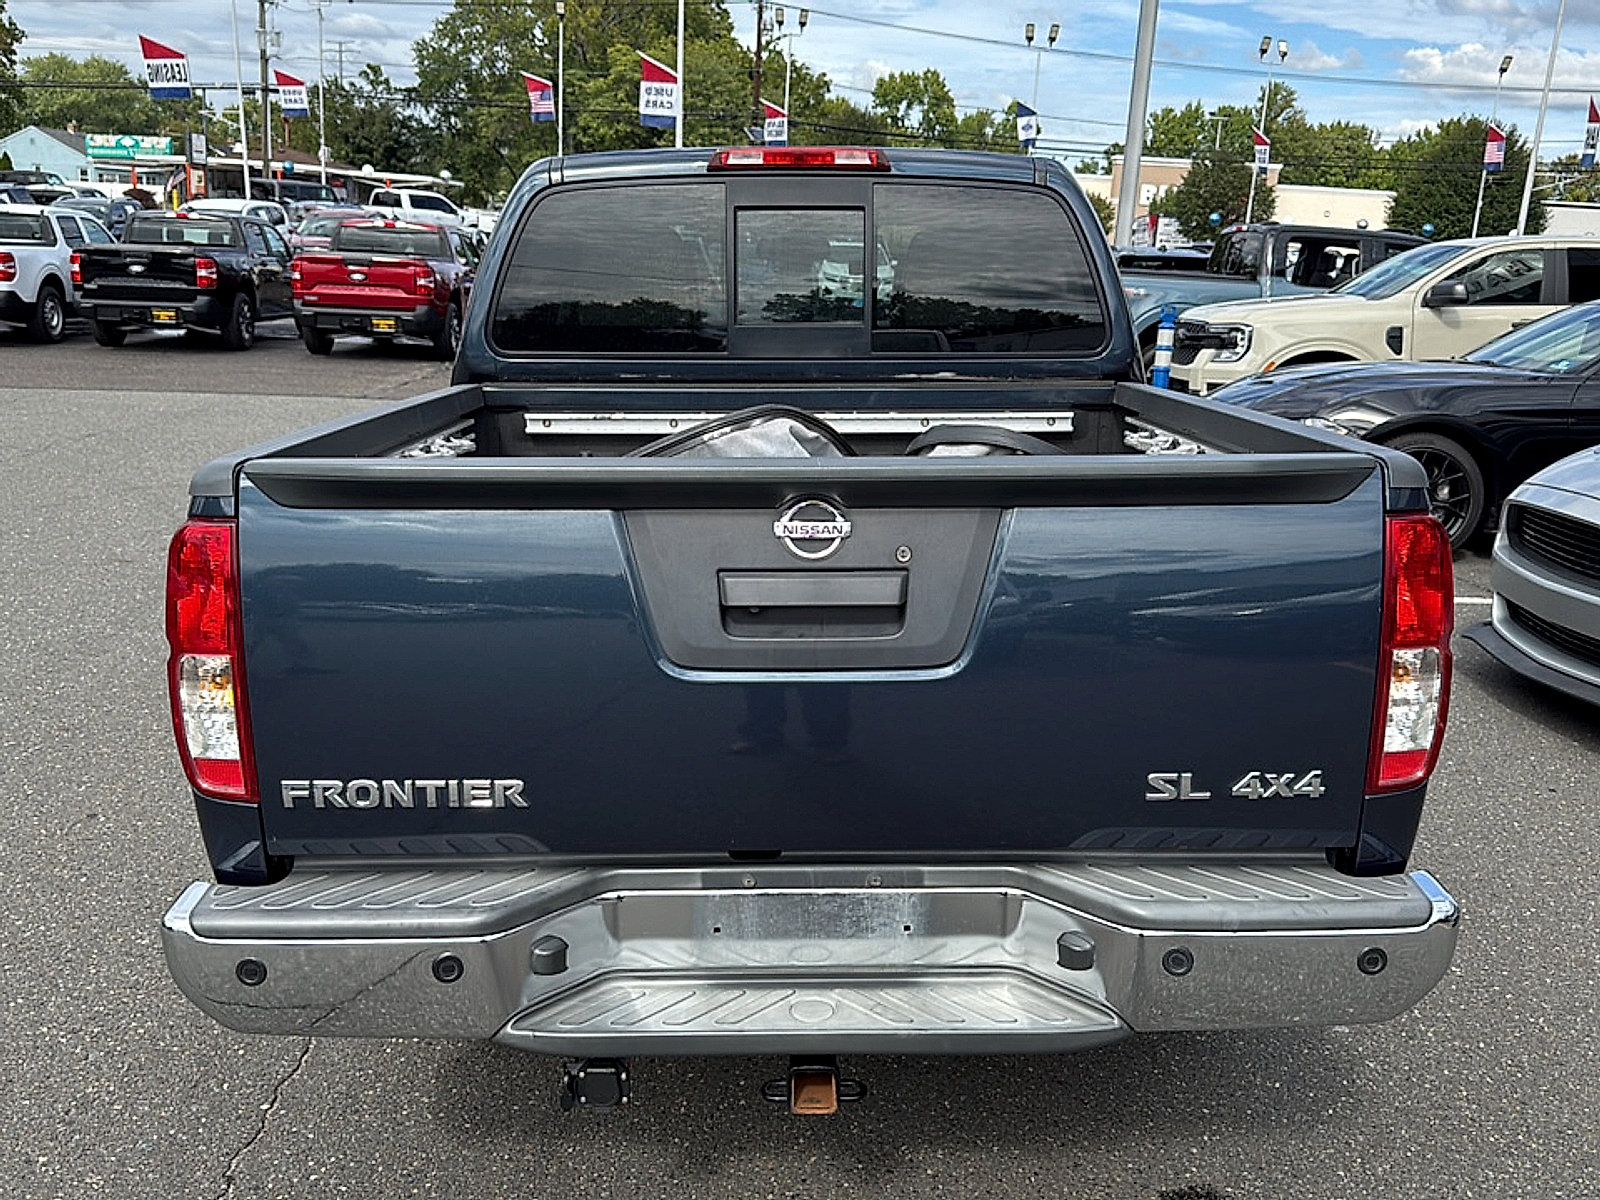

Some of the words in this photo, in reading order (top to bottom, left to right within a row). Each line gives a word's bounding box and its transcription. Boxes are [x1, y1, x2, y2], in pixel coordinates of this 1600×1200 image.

[783, 525, 843, 535] NISSAN
[279, 779, 529, 809] FRONTIER
[1145, 772, 1212, 800] SL
